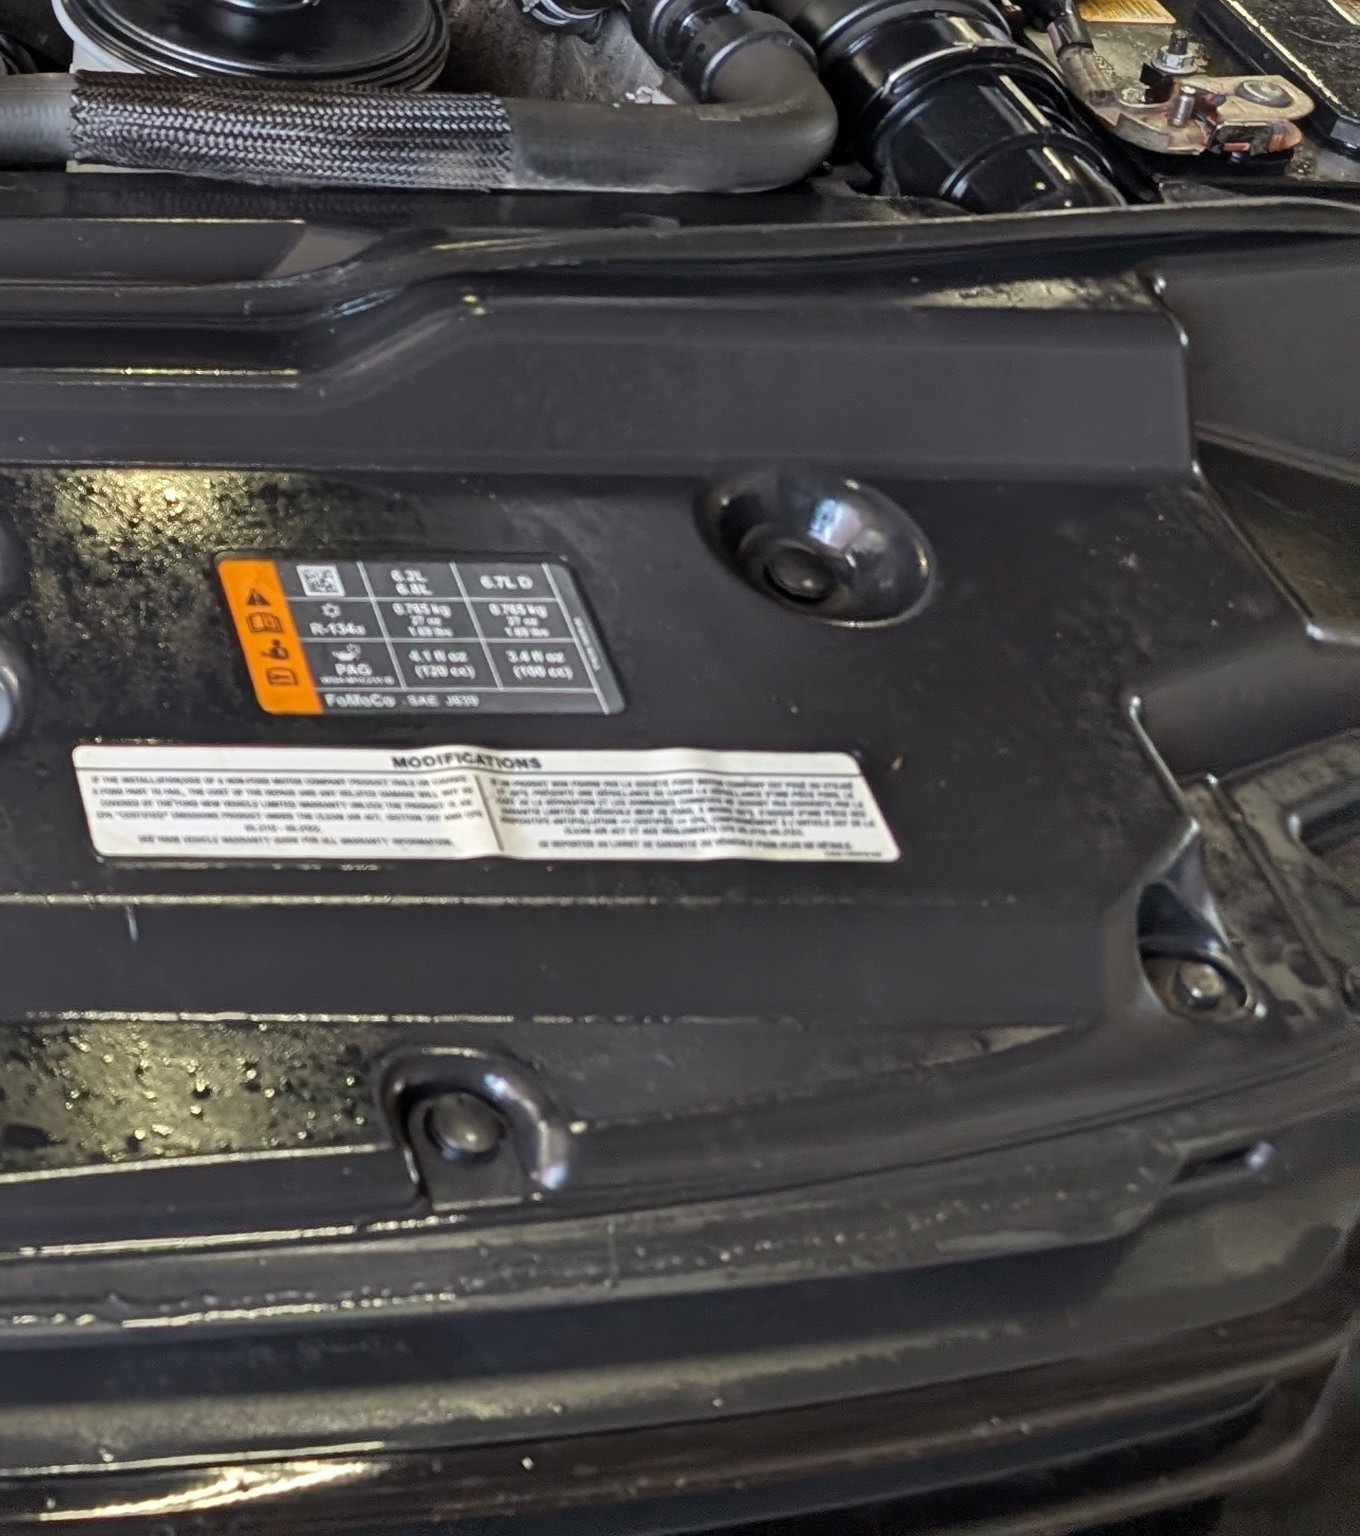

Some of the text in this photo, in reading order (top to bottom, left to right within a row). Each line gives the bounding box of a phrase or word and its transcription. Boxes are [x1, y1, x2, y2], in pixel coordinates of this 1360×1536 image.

[480, 575, 533, 590] 6.7L D
[431, 604, 452, 618] kg
[526, 604, 548, 619] kg
[309, 622, 366, 635] R-134a
[335, 663, 372, 676] PAG
[324, 693, 479, 708] FoMoCo SAE J639
[391, 751, 542, 769] MODIFICATIONS
